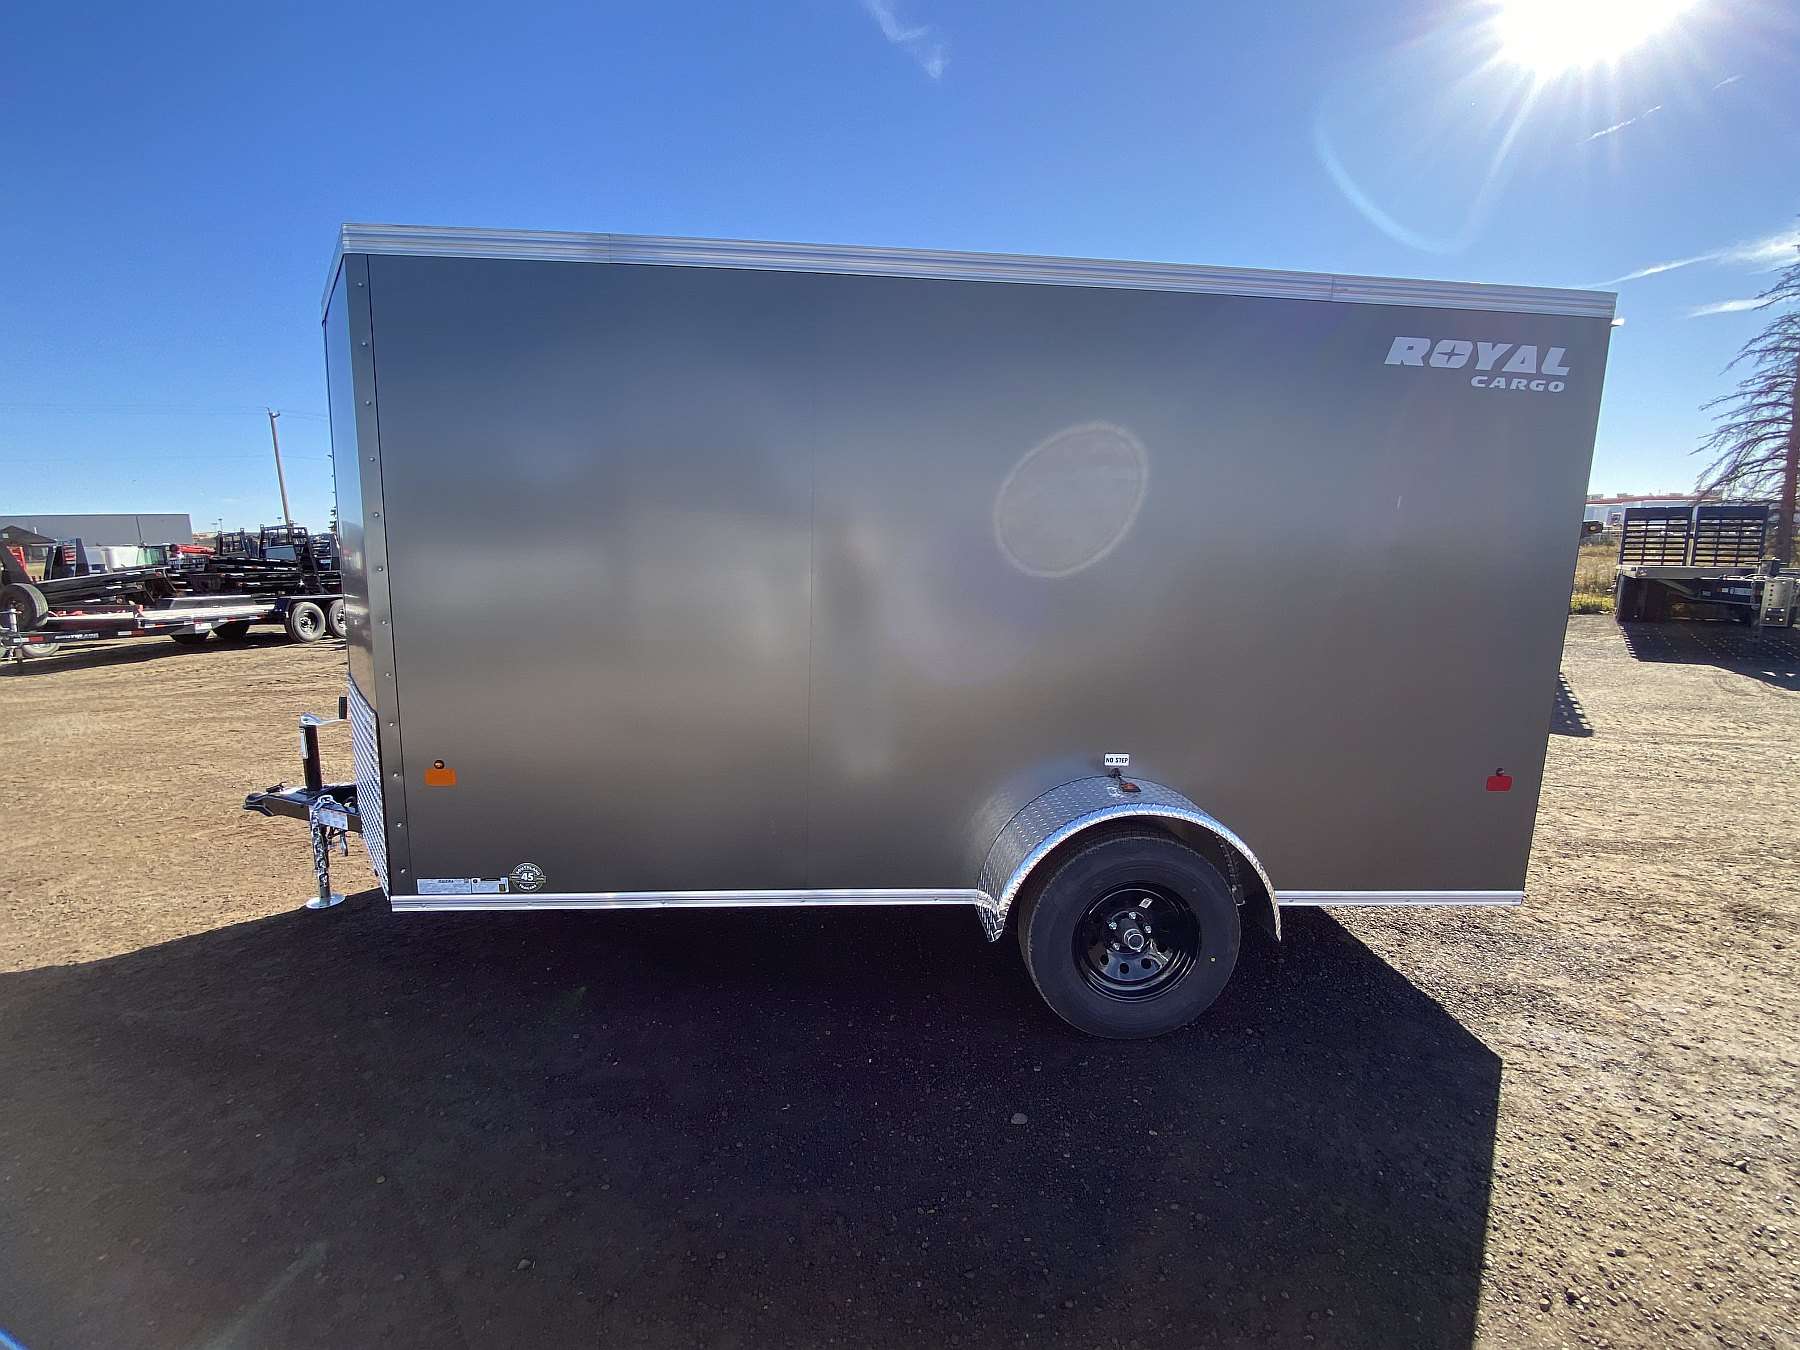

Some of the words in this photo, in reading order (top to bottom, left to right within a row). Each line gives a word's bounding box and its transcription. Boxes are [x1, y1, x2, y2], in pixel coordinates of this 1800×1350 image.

[1384, 336, 1571, 376] ROYAL
[1470, 375, 1565, 393] CARGO
[521, 872, 534, 881] 45
